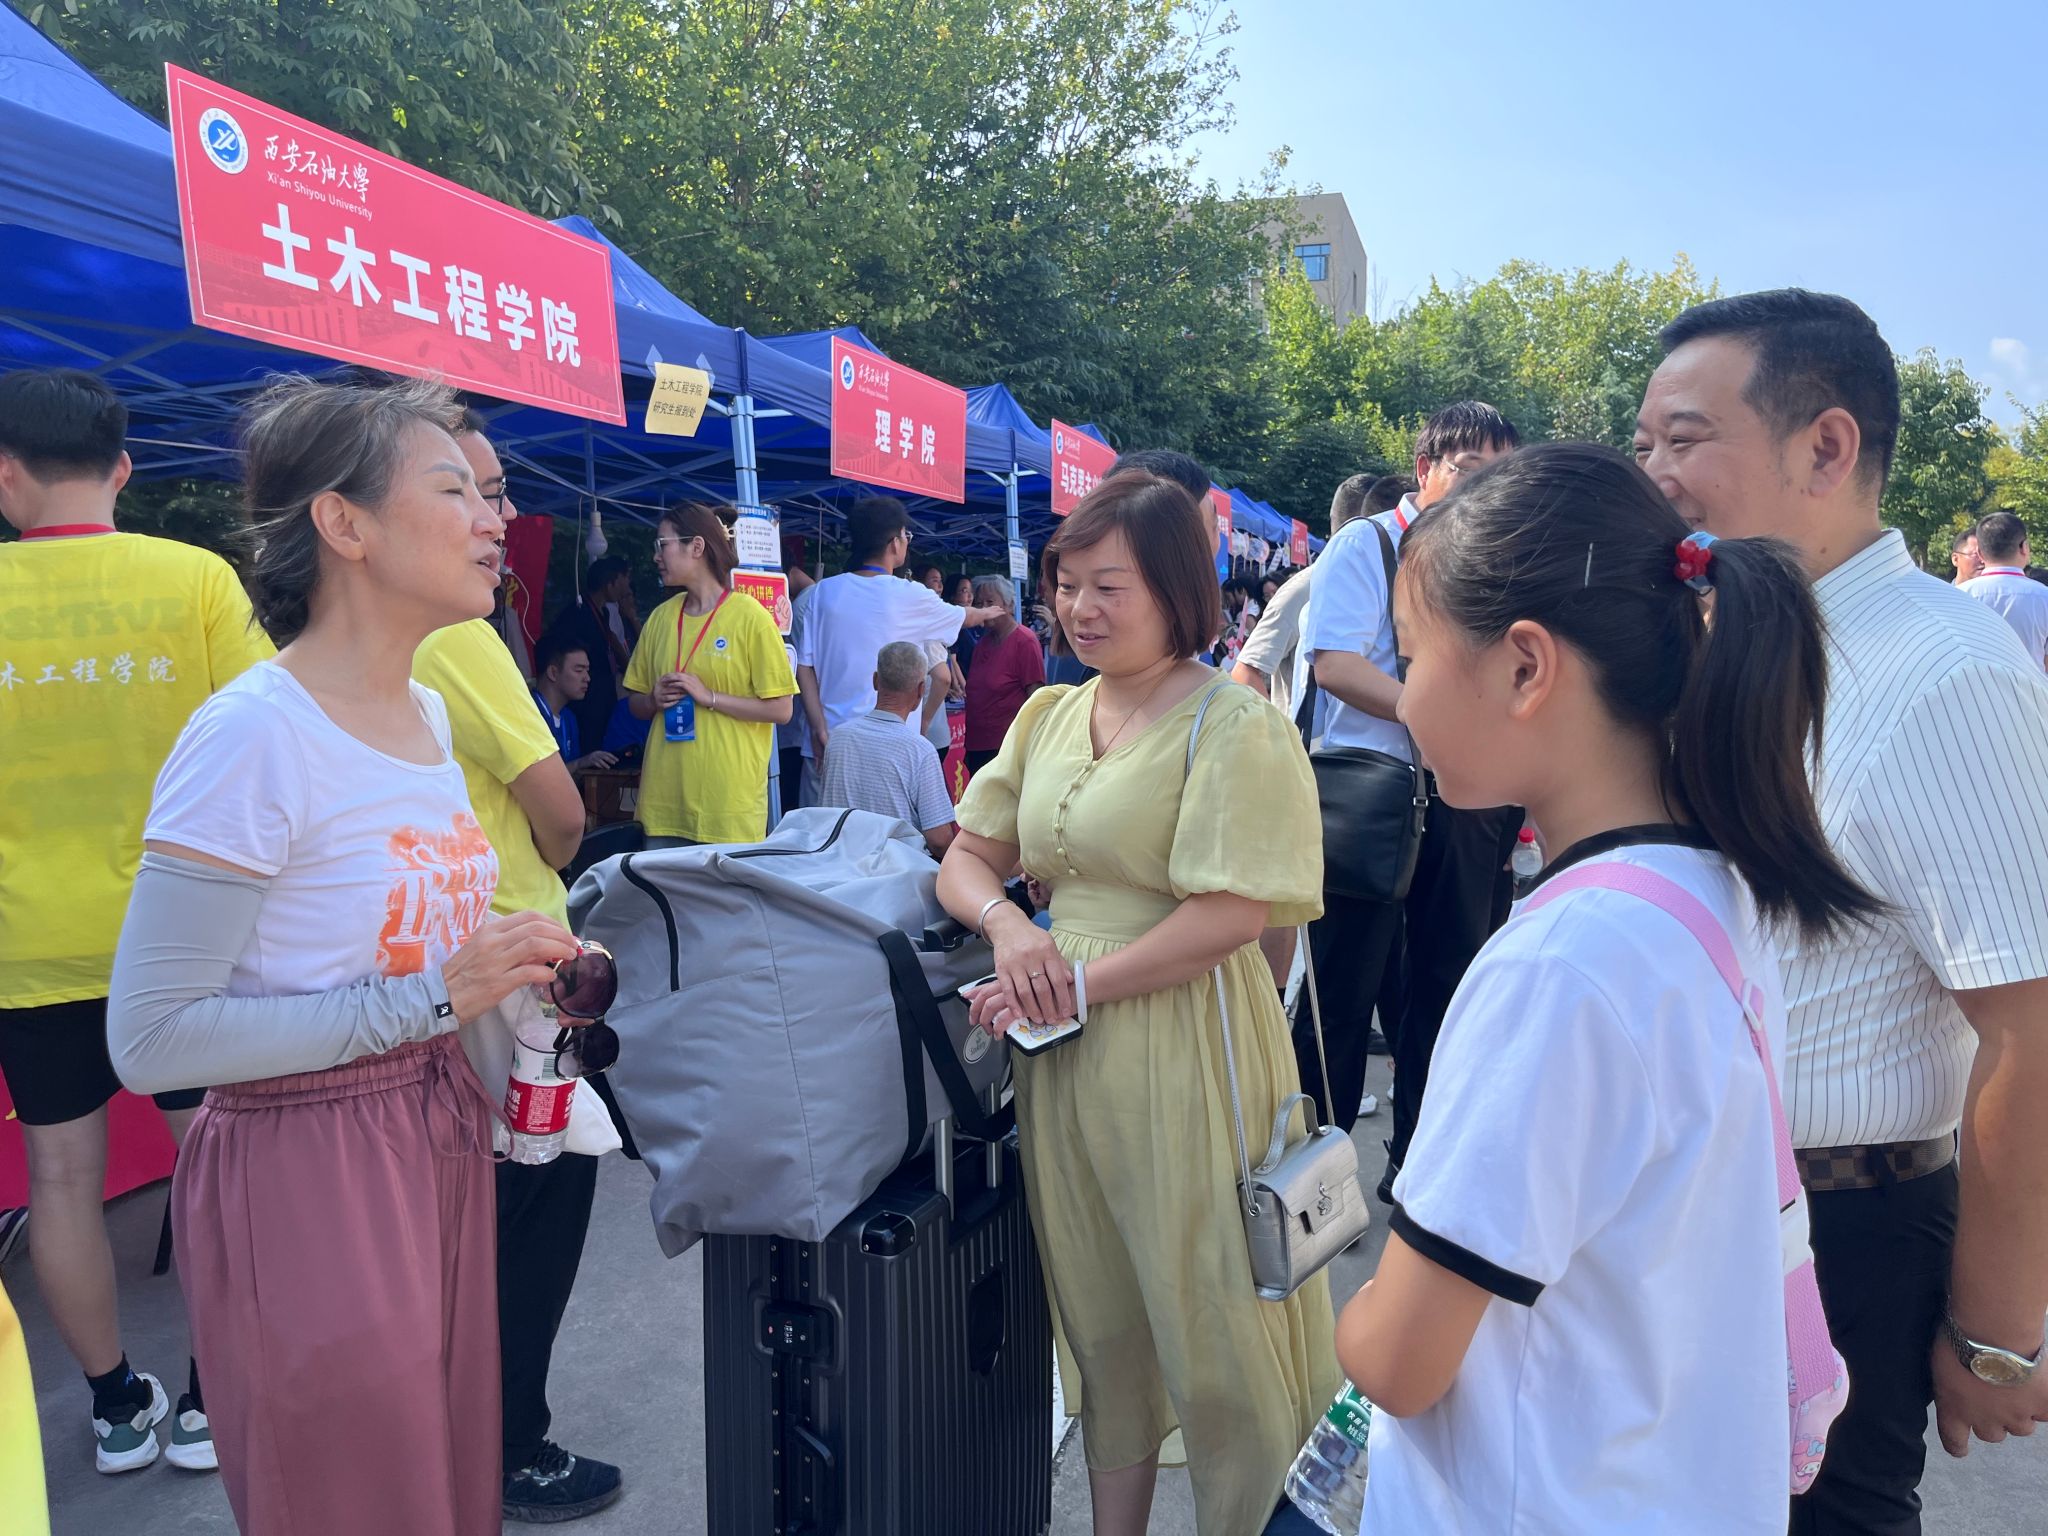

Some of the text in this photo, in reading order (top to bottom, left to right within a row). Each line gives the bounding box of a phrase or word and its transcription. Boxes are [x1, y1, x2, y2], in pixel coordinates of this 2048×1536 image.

[267, 171, 373, 221] Xi'an Shiyou University
[262, 203, 581, 368] 土木工程学院
[659, 379, 703, 396] 土木工程学院
[653, 401, 696, 418] 研究生报到处
[875, 408, 936, 466] 理学院
[1060, 461, 1102, 498] 马克思主
[0, 652, 176, 690] 木工程学院
